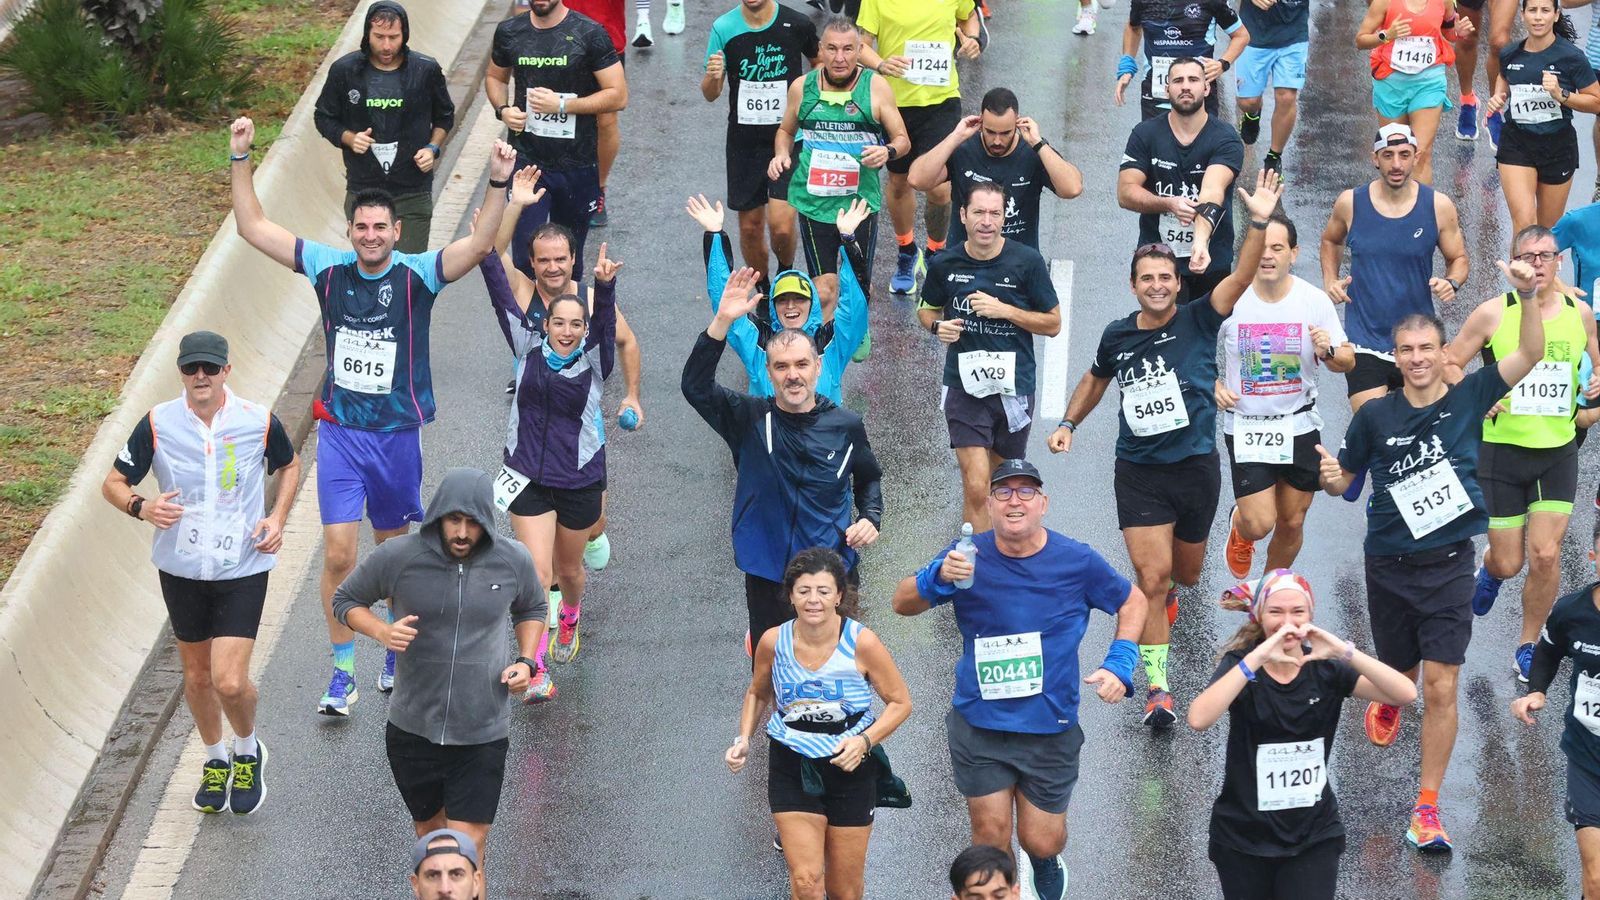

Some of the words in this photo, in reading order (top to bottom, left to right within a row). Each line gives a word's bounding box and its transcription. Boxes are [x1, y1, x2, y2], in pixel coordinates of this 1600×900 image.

[518, 55, 568, 68] mayoral
[757, 53, 786, 70] Agua
[910, 58, 948, 71] 11244
[1397, 49, 1433, 65] 11416
[746, 98, 780, 111] 6612
[1514, 100, 1556, 114] 11206
[815, 121, 856, 131] ATLETISMO
[820, 172, 848, 187] 125
[1166, 229, 1194, 243] 545
[1547, 340, 1555, 358] 2015
[343, 357, 384, 378] 6615
[970, 366, 1006, 382] 1129
[1518, 383, 1569, 399] 11037
[1134, 396, 1176, 420] 5495
[1245, 432, 1285, 447] 3729
[497, 468, 522, 494] 775
[1412, 483, 1453, 517] 5137
[982, 660, 1038, 684] 20441
[1266, 765, 1321, 789] 11207
